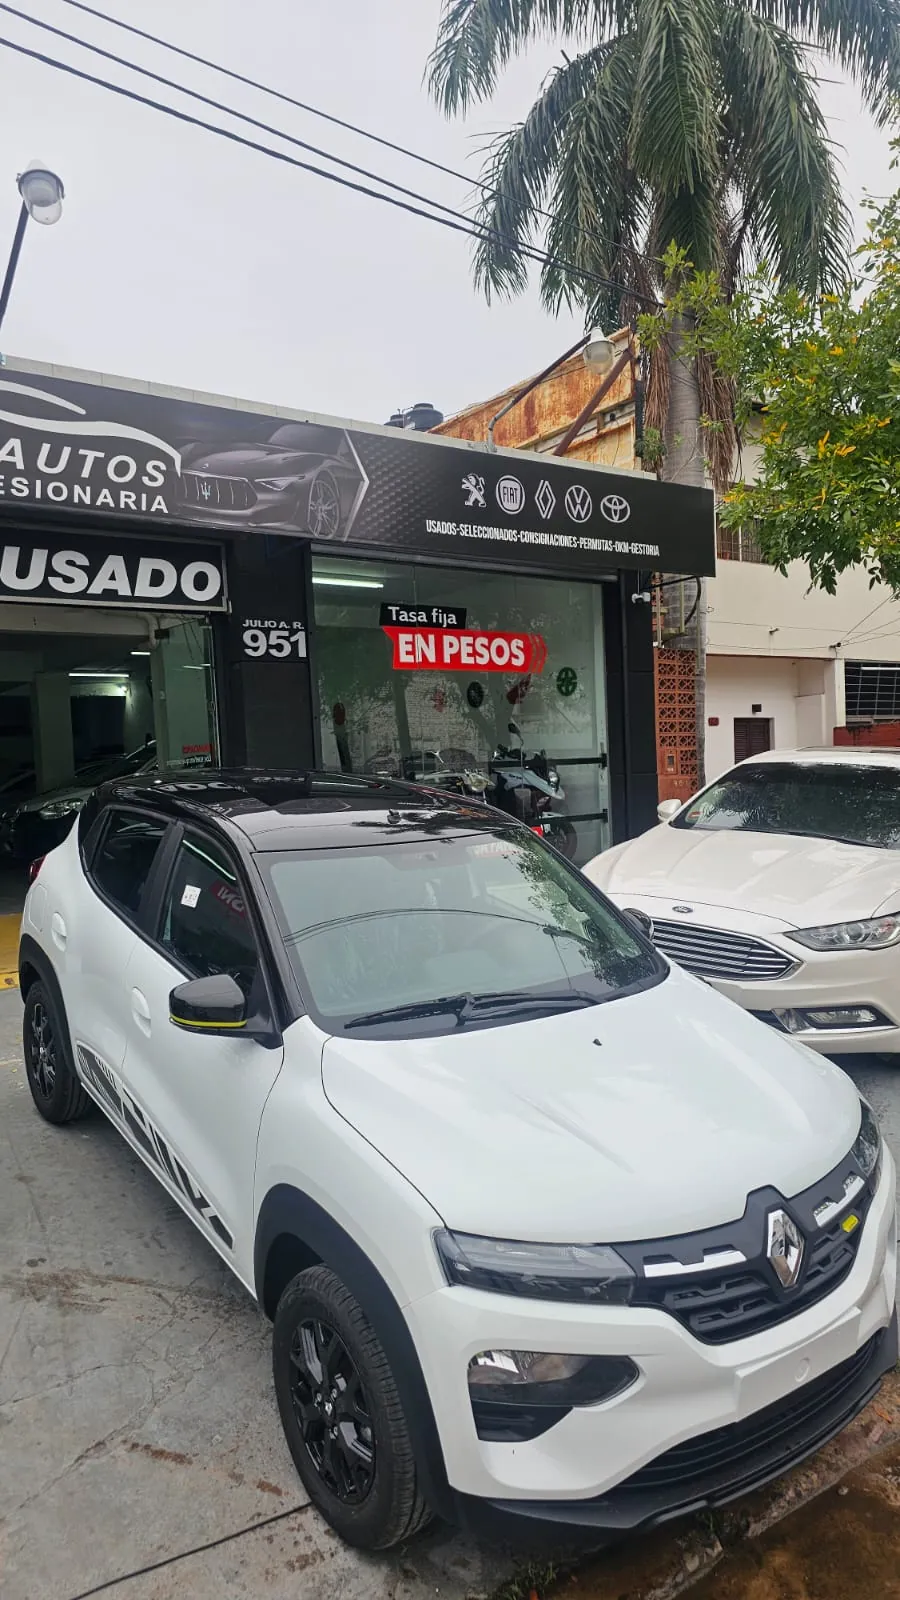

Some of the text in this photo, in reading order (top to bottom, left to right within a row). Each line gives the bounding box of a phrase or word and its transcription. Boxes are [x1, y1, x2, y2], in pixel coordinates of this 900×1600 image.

[0, 438, 167, 487] AUTOS
[503, 486, 518, 504] FIAT
[0, 546, 221, 601] USADO
[242, 619, 305, 630] JULIO A. R.
[388, 606, 457, 628] Tasa fija
[242, 629, 307, 658] 951
[398, 633, 525, 667] EN PESOS
